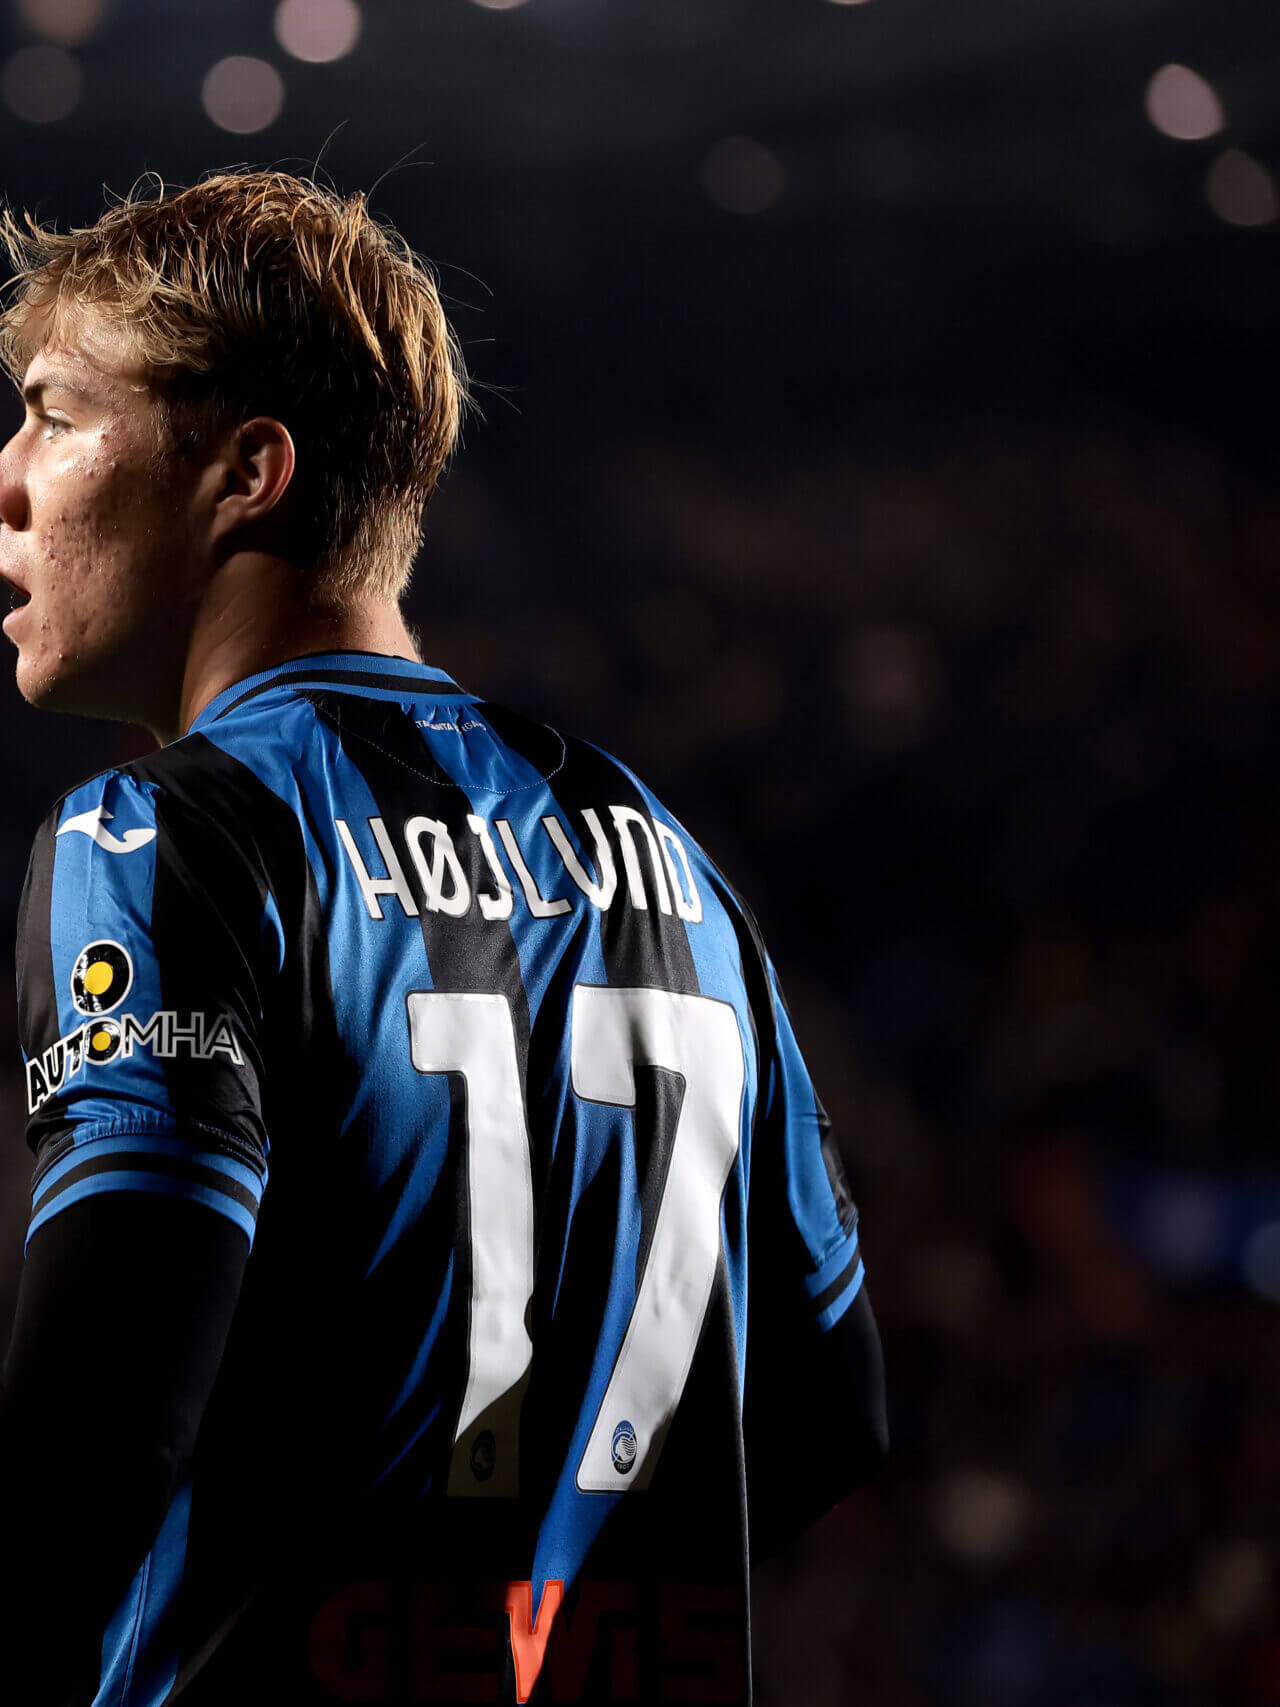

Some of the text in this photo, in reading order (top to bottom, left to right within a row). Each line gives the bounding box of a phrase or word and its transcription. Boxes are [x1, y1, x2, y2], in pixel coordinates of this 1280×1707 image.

[335, 805, 703, 923] HØJLUND
[26, 1011, 245, 1115] AUTOMHA
[407, 984, 745, 1496] 17
